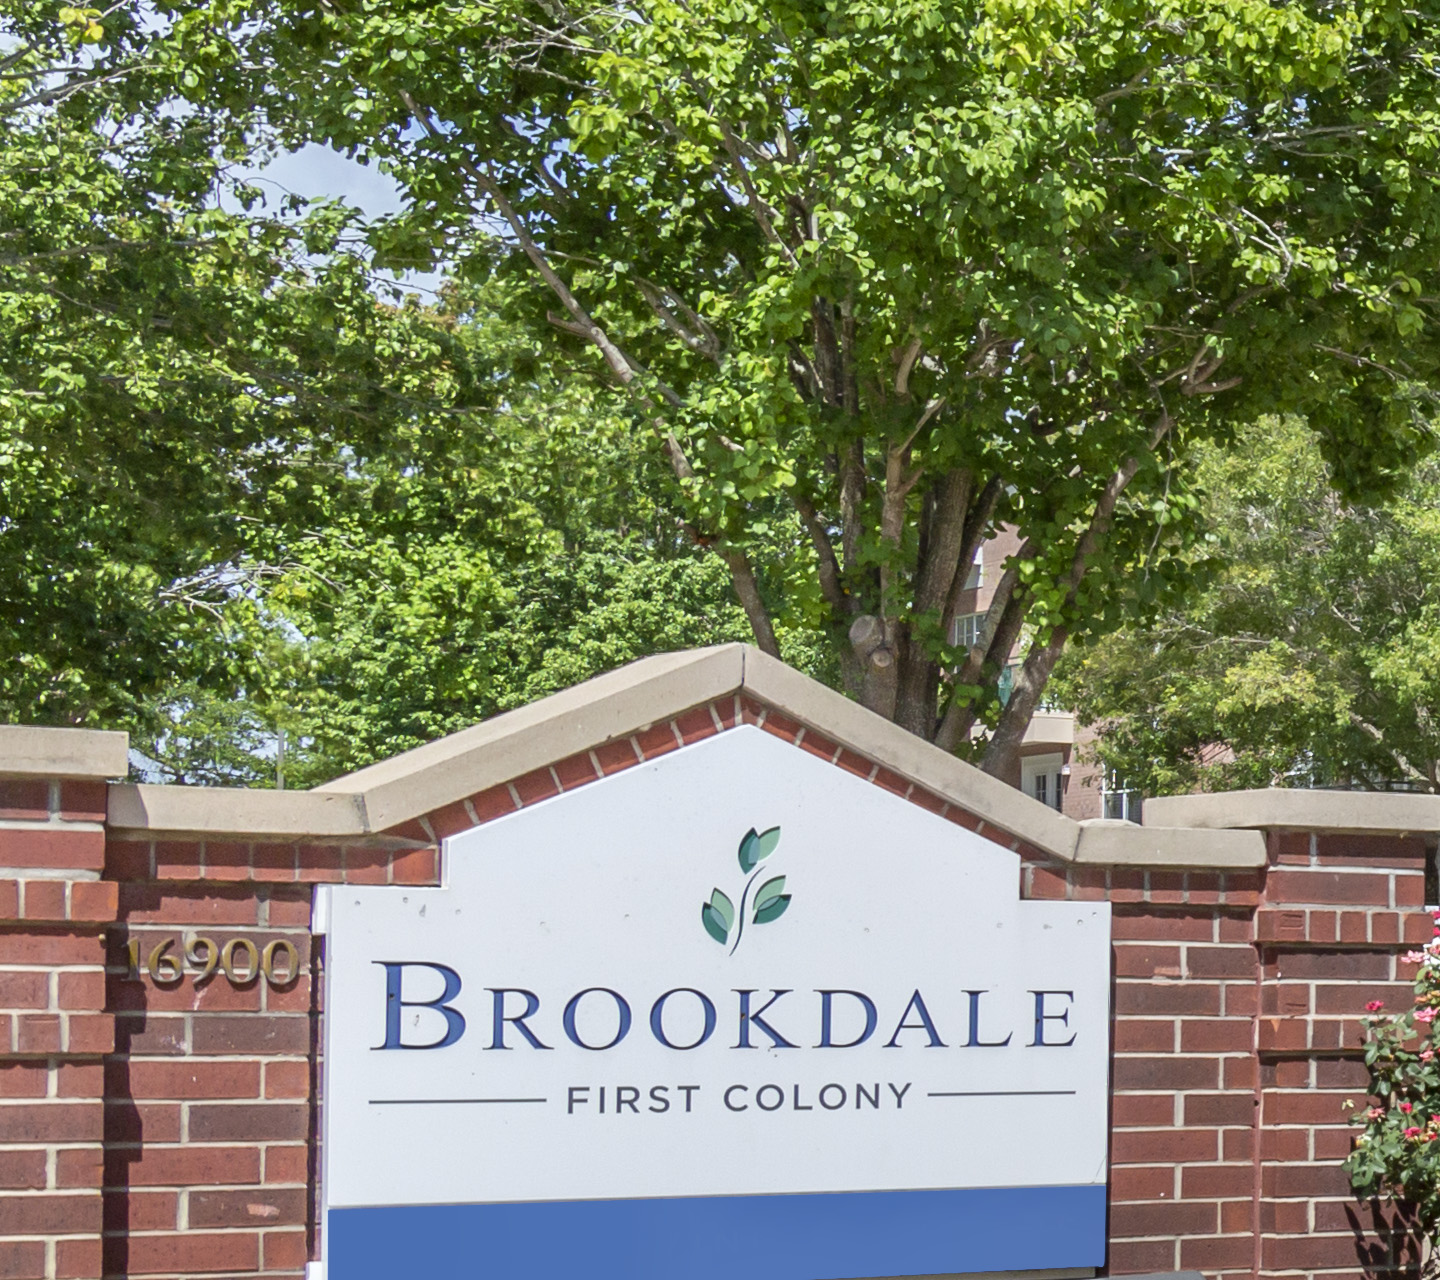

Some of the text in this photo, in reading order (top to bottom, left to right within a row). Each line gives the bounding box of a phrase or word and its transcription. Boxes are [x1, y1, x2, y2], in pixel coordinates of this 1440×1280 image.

[119, 936, 300, 986] 16900
[369, 960, 1078, 1051] BROOKDALE
[567, 1082, 913, 1114] FIRST COLONY
